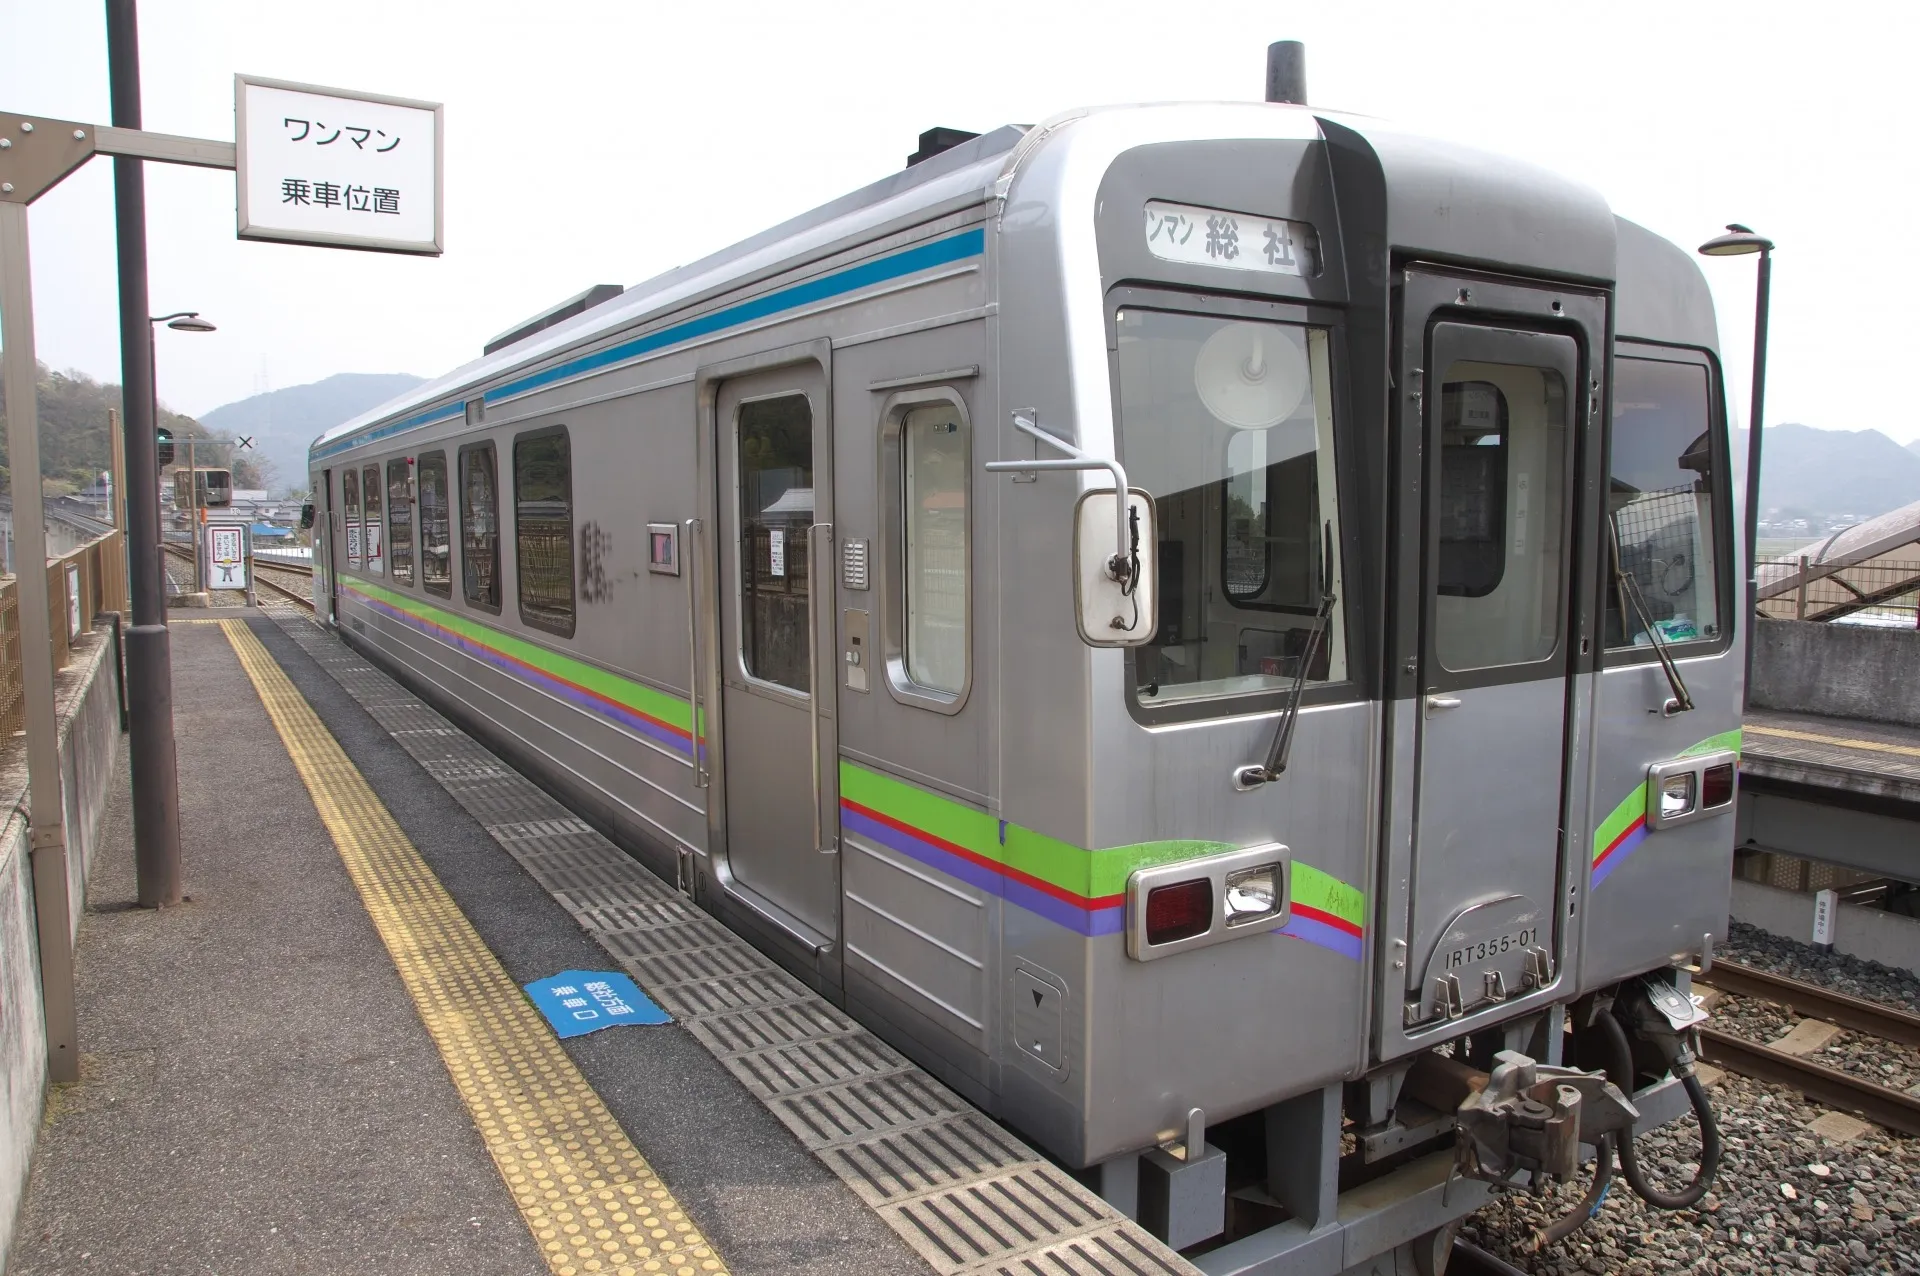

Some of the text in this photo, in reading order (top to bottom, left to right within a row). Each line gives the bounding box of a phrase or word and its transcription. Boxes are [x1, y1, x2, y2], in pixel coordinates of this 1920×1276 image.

[284, 117, 400, 153] ワンマン
[282, 178, 400, 215] 乗車位置
[1143, 210, 1296, 267] ンマン 総社
[1445, 927, 1537, 970] IRT355-01
[551, 985, 599, 1020] 乗車口
[584, 981, 635, 1016] 総社方面
